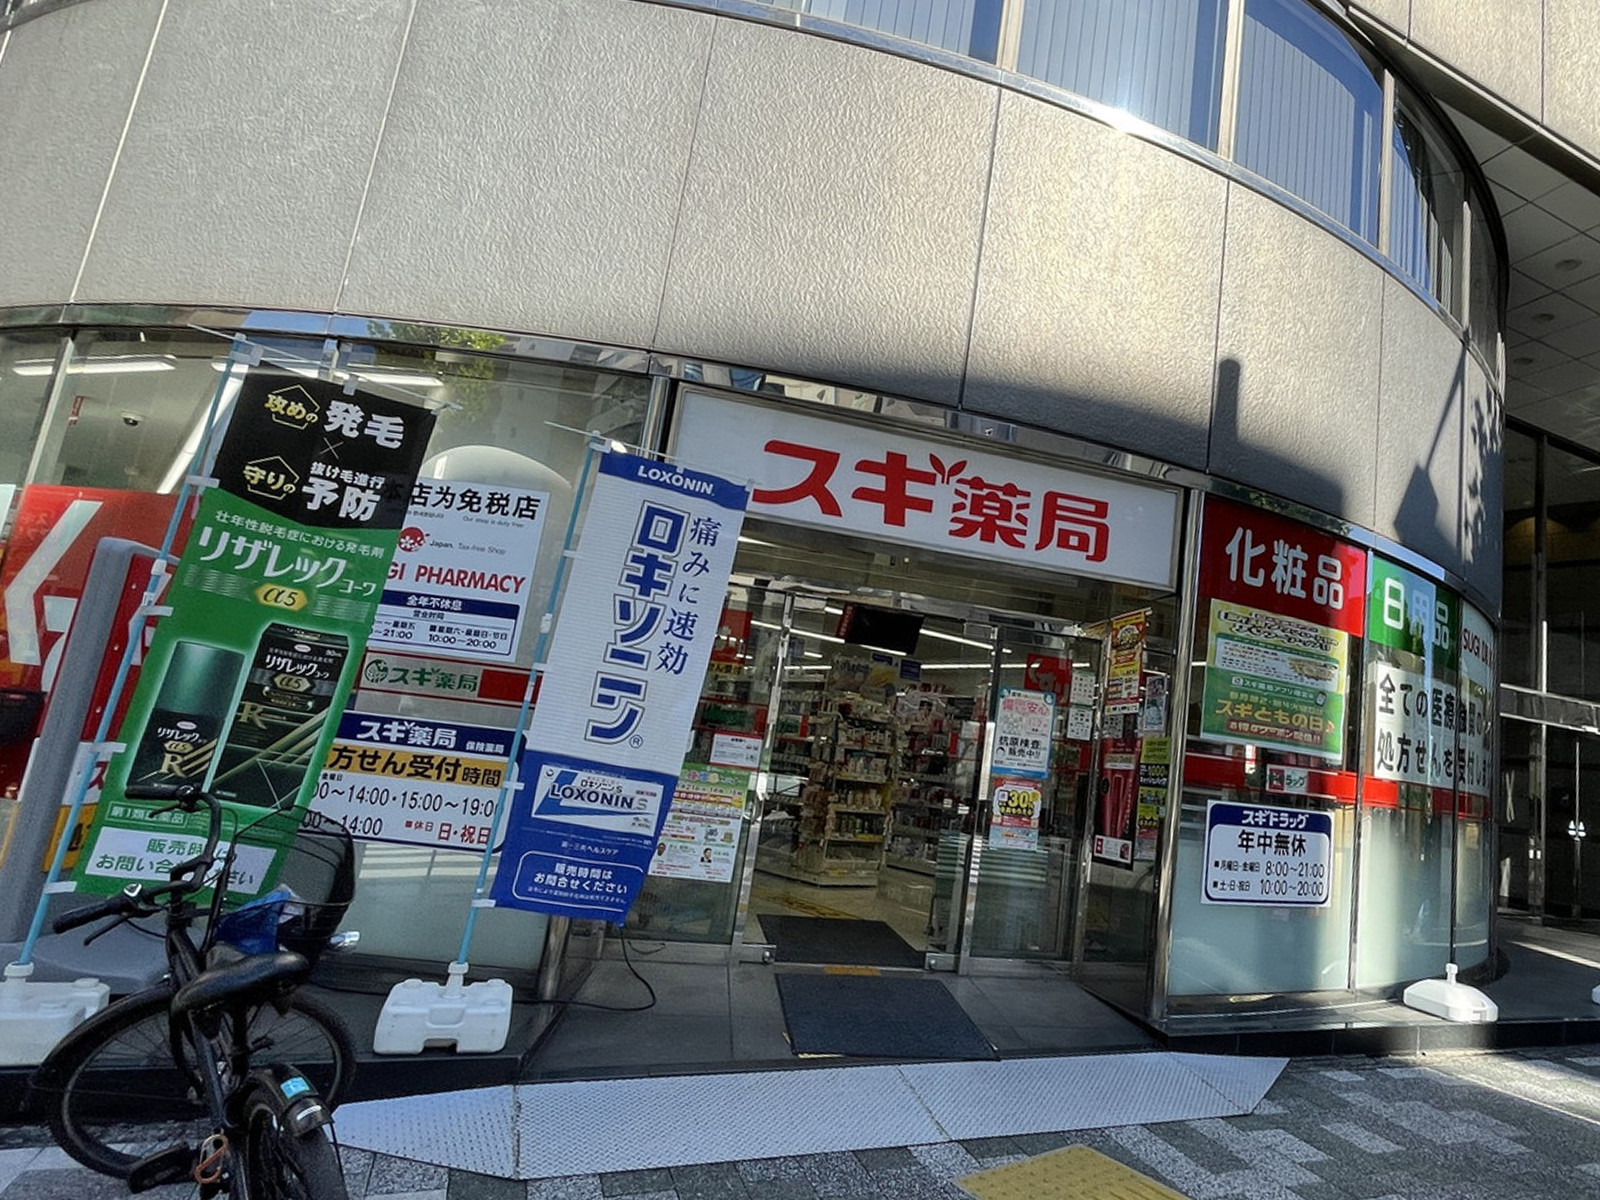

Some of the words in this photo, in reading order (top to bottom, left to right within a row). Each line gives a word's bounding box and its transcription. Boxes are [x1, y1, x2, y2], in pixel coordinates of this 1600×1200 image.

[264, 393, 319, 424] 攻めの
[324, 400, 405, 449] 発毛
[242, 464, 297, 495] 守りの
[637, 465, 714, 495] LOXONIN
[302, 475, 382, 522] 予防
[410, 482, 541, 520] 店为免税店
[752, 439, 1110, 563] スギ薬局
[198, 526, 347, 588] リザレック
[1225, 526, 1344, 611] 化粧品
[387, 561, 405, 580] GI
[415, 565, 526, 594] PHARMACY
[655, 518, 722, 675] 痛みに速効
[1382, 577, 1450, 650] 日用品
[584, 499, 690, 745] ロキソニン
[388, 666, 479, 692] スギ薬局
[356, 720, 458, 749] スギ薬局
[322, 745, 501, 787] 方せん受付時間
[549, 784, 634, 810] LOXONIN
[1241, 808, 1309, 829] スギドラッグ
[1238, 829, 1307, 857] 年中無休
[533, 873, 628, 894] お問合せください
[555, 862, 614, 881] 販売時間は
